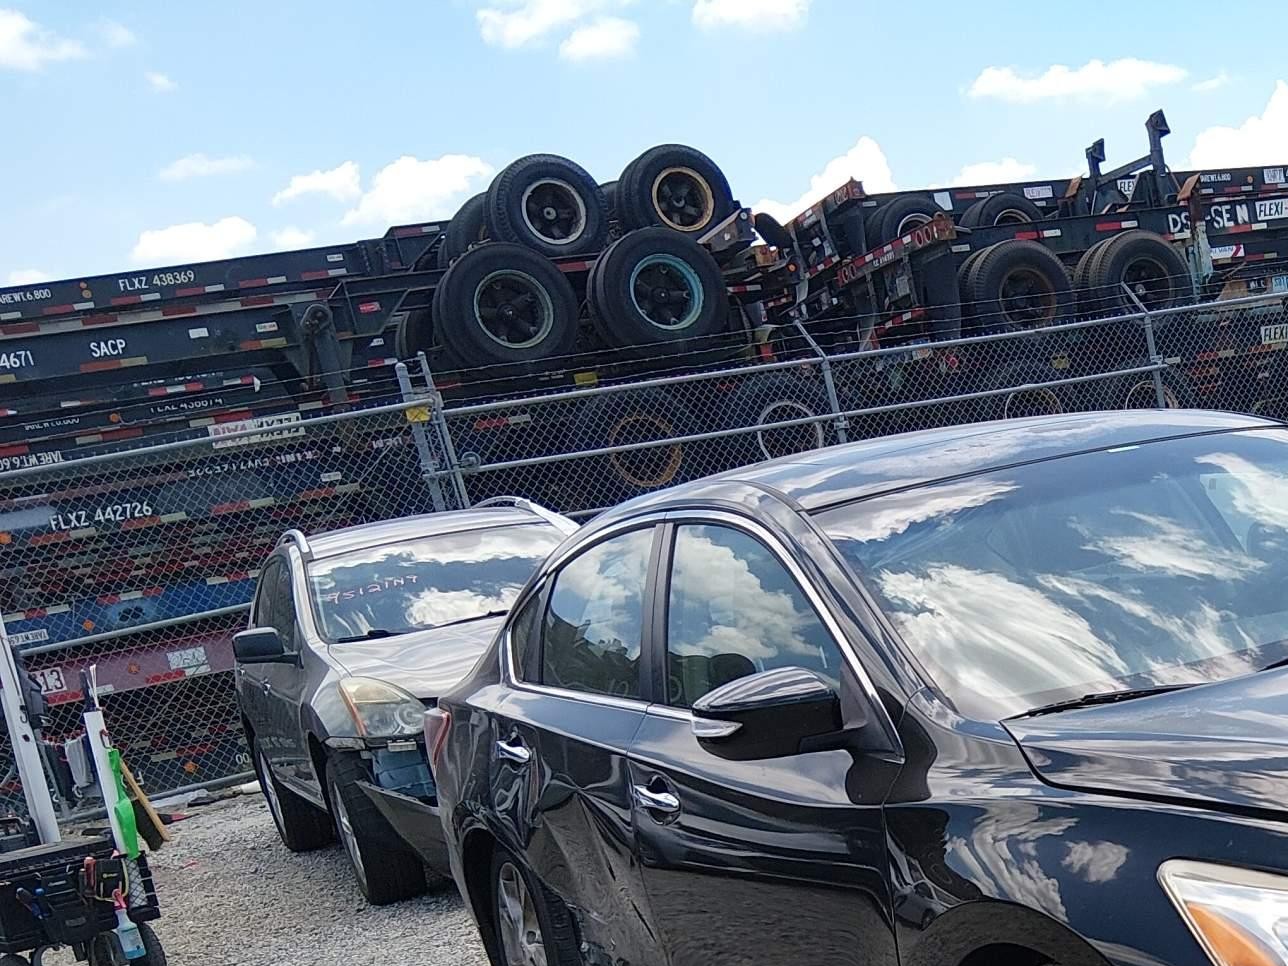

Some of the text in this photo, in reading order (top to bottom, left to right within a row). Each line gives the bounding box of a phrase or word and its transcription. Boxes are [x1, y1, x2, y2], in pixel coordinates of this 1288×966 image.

[119, 270, 195, 292] FLXZ 438369
[90, 340, 126, 358] SACP
[51, 500, 152, 530] FLXZ 442726
